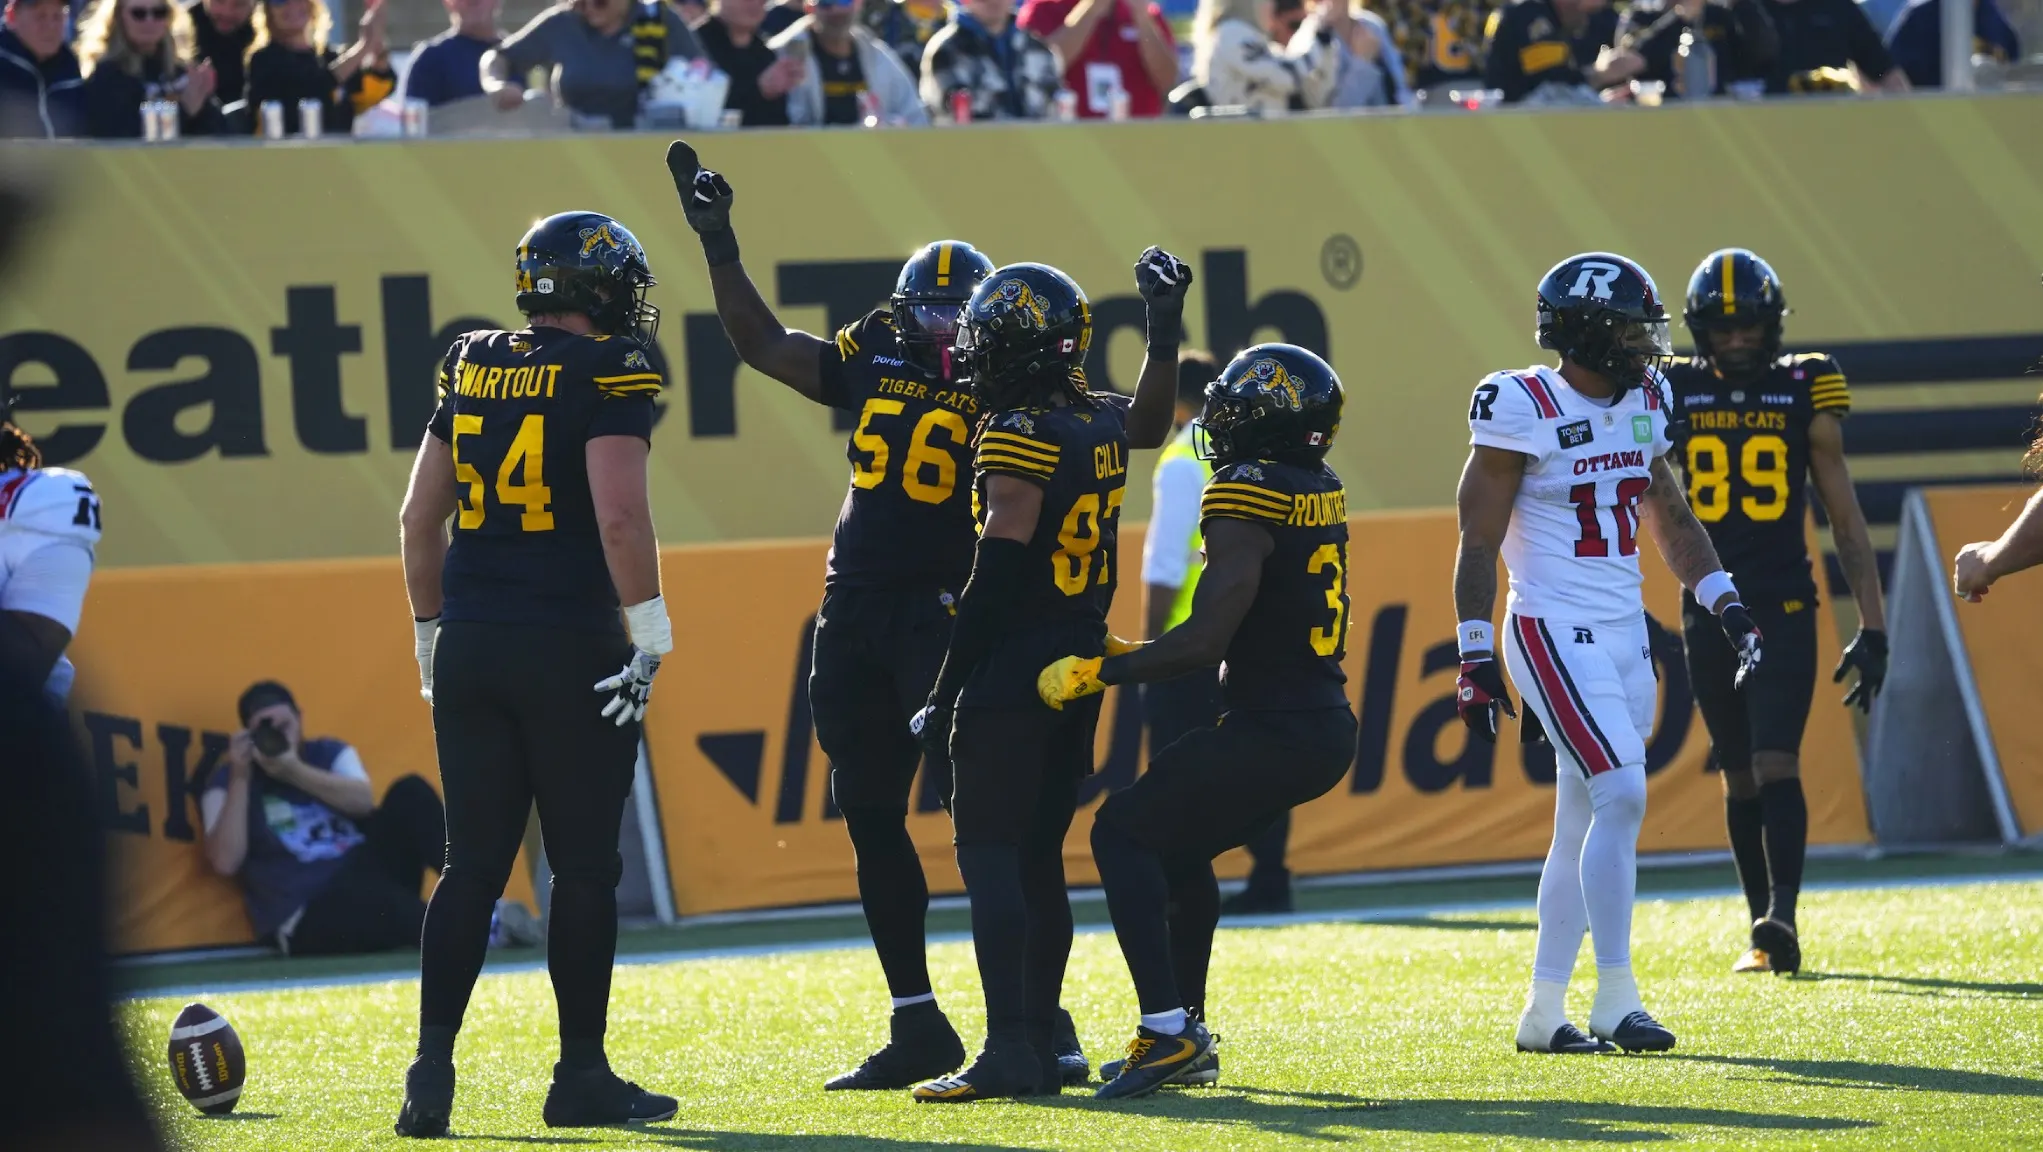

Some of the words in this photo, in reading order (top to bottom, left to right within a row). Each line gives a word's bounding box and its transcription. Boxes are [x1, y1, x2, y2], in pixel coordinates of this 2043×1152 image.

[454, 360, 562, 400] SWARTOUT
[877, 377, 979, 415] TIGER-CATS
[1689, 411, 1787, 430] TIGER-CATS
[853, 398, 968, 505] 56
[1094, 441, 1125, 480] GILL
[1573, 450, 1645, 476] OTTAWA
[452, 414, 555, 531] 54
[1686, 434, 1789, 522] 89
[1287, 488, 1347, 527] ROUNTRE
[1569, 477, 1652, 558] 10
[1469, 630, 1485, 641] CFL
